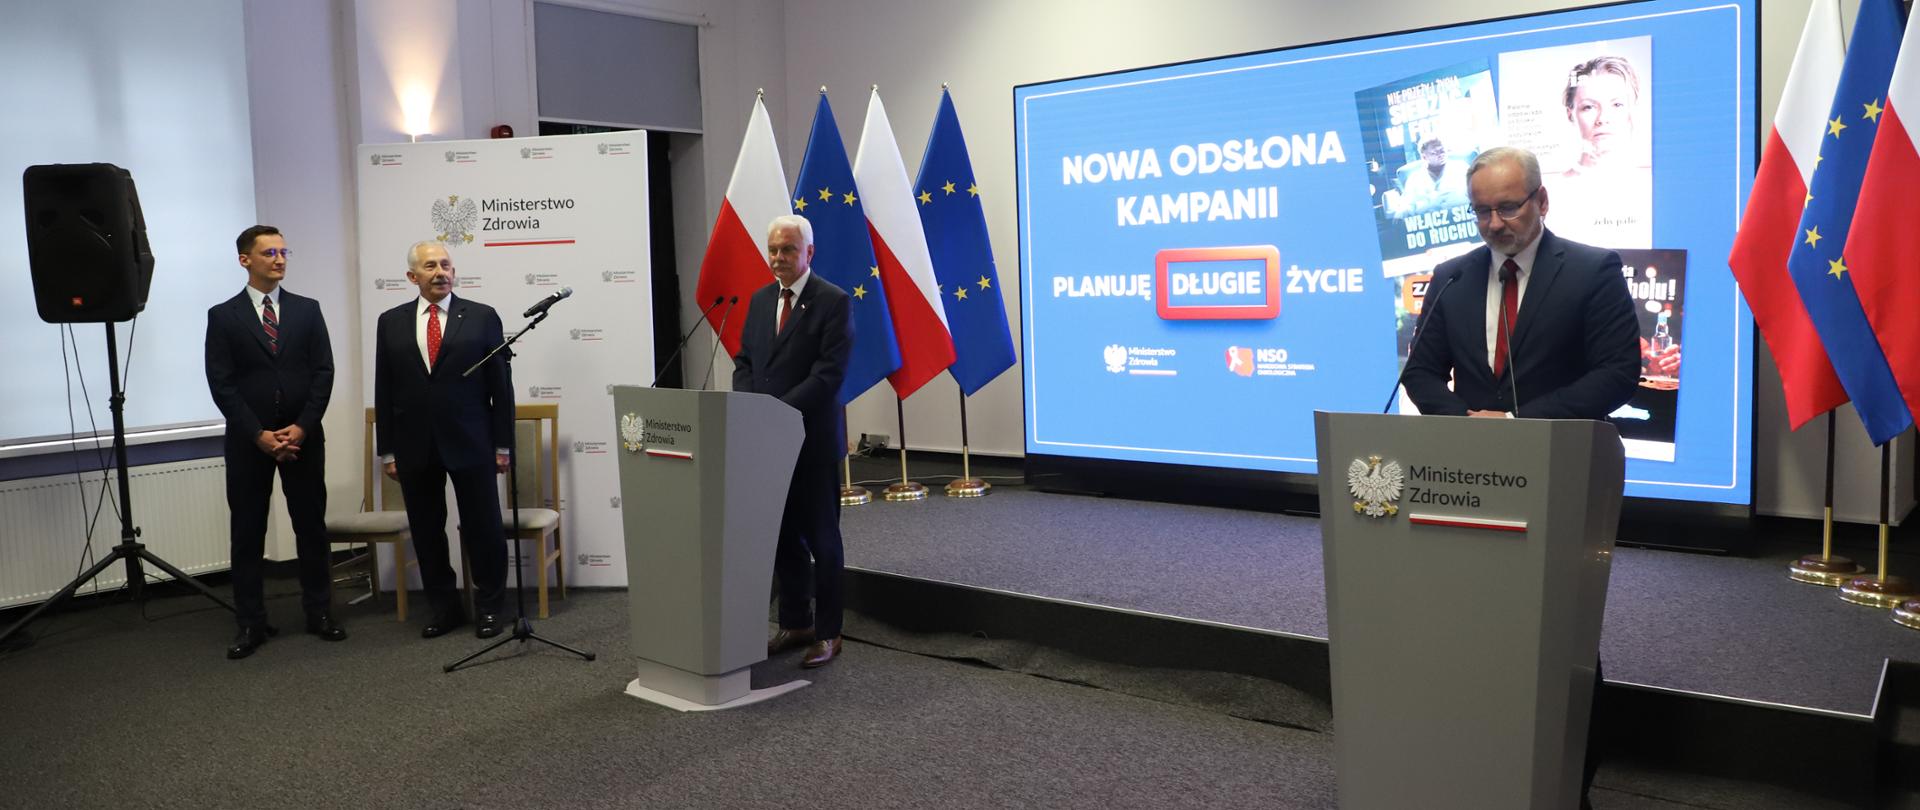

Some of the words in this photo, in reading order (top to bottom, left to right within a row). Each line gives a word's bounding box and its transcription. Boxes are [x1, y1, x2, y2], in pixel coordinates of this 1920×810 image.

[1063, 148, 1162, 185] NOWA
[1169, 130, 1347, 177] ODSŁONA
[482, 197, 575, 212] Ministerstwo
[1117, 186, 1279, 227] KAMPANII
[482, 216, 540, 231] Zdrowia
[1406, 231, 1426, 250] DO
[1429, 221, 1478, 245] RUCHU
[1053, 274, 1151, 301] PLANUJĘ
[1172, 271, 1261, 296] DŁUGIE
[1286, 265, 1364, 294] ŻYCIE
[1128, 346, 1176, 356] Ministerstwo
[1257, 348, 1288, 363] NSO
[646, 418, 692, 433] Ministerstwo
[646, 432, 675, 445] Zdrowia
[1410, 465, 1527, 488] Ministerstwo
[1409, 487, 1481, 507] Zdrowia
